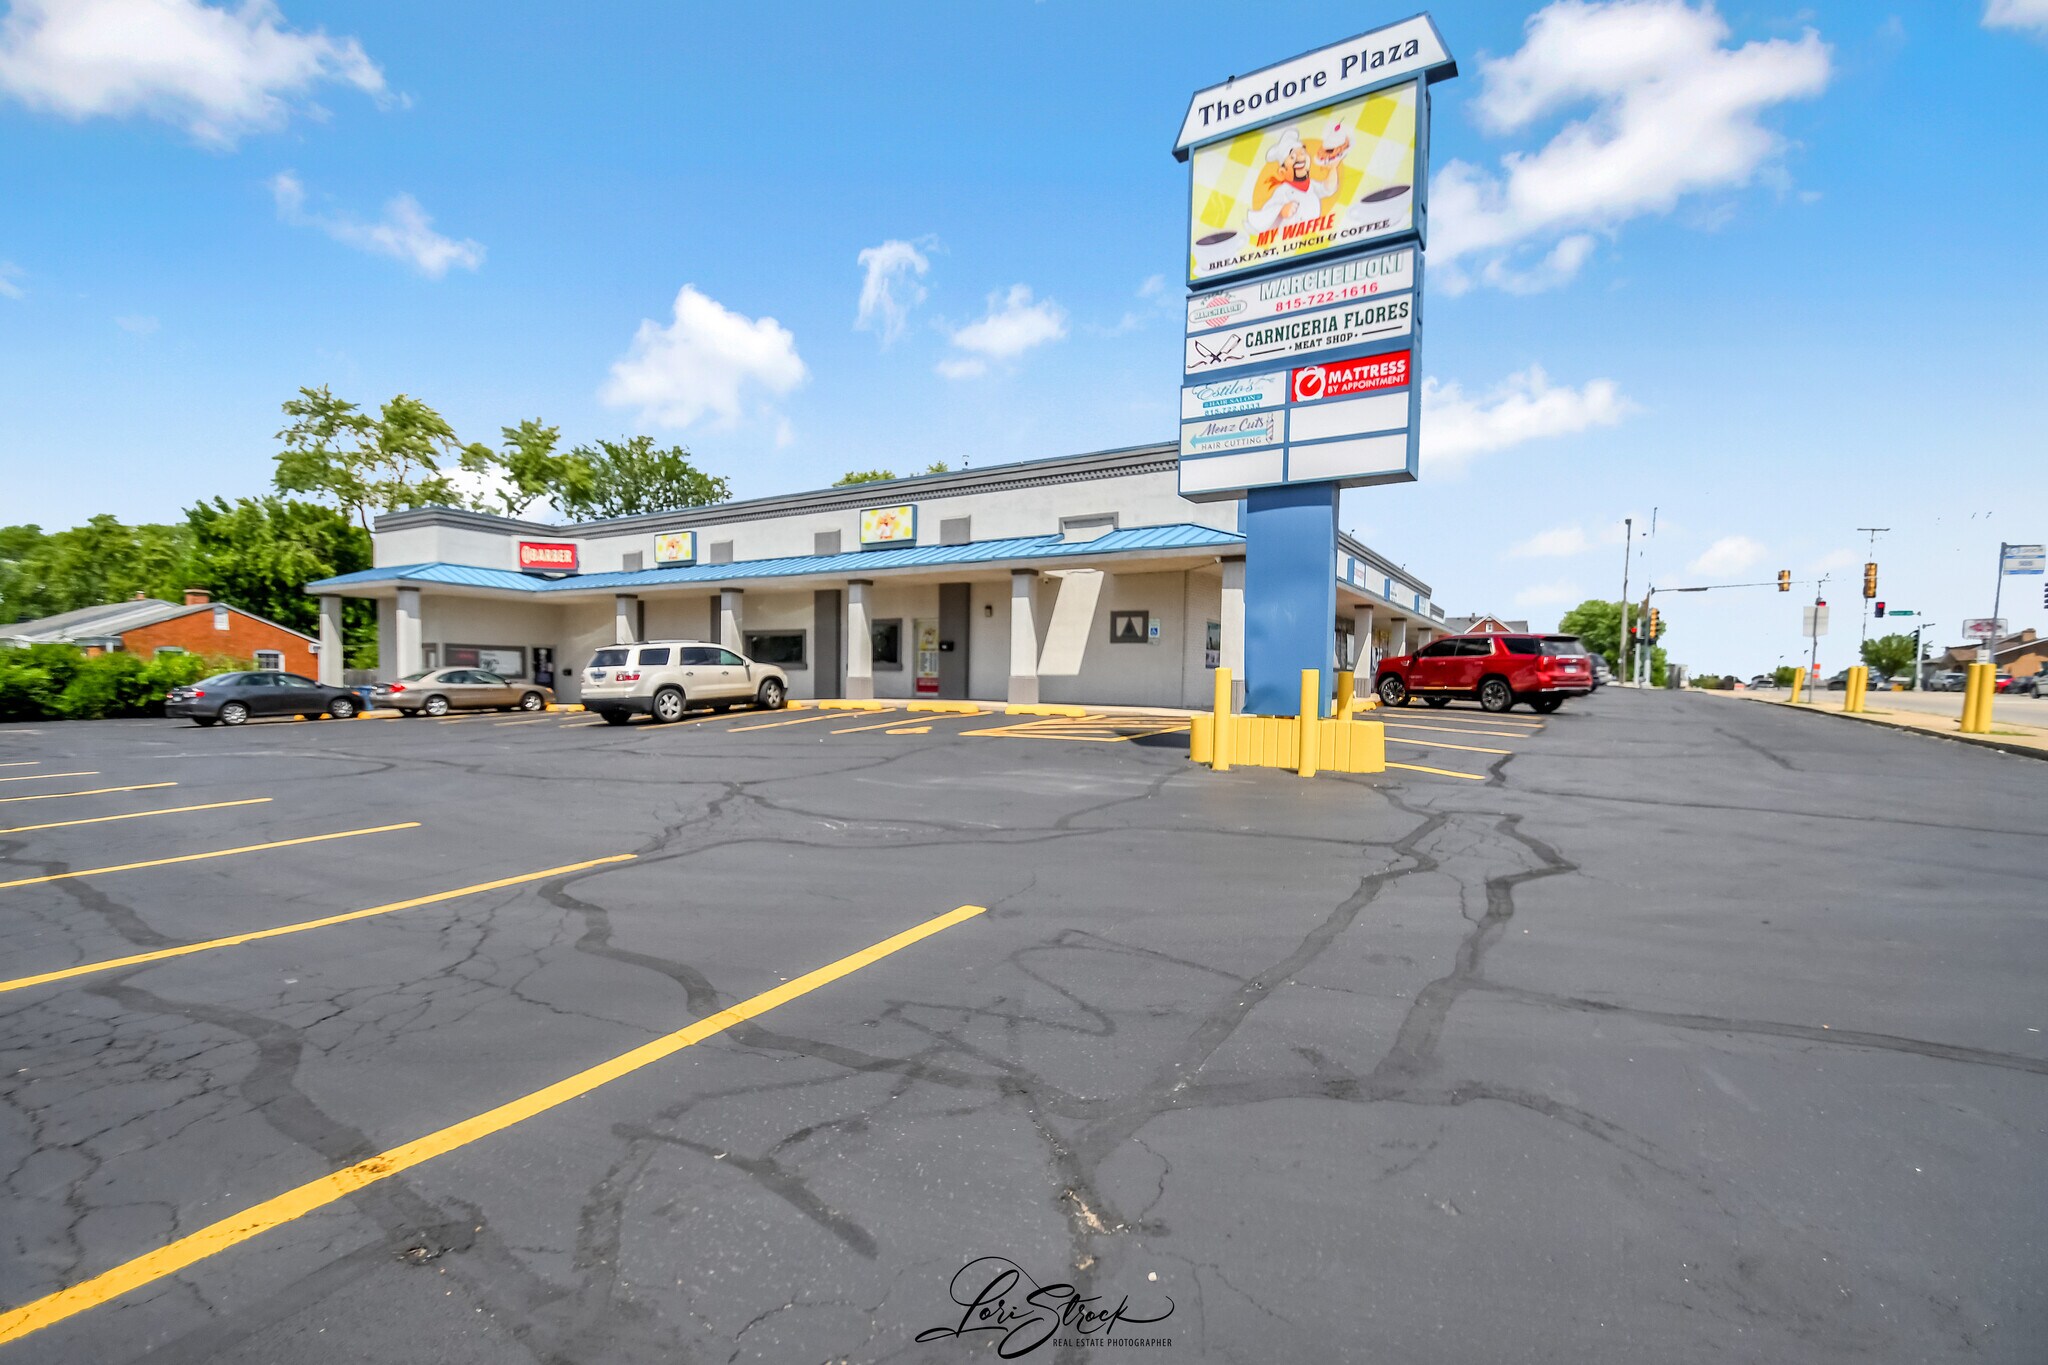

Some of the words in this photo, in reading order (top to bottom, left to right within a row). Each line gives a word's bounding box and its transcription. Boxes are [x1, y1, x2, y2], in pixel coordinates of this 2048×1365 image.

[1198, 70, 1327, 127] Theodore
[1340, 38, 1419, 79] Plaza
[1256, 228, 1278, 247] MY
[1282, 213, 1336, 240] WAFFLE
[1209, 247, 1280, 270] BREAKFAST,
[1283, 236, 1324, 252] LUNCH
[1328, 232, 1337, 241] &
[1340, 219, 1390, 238] COFFEE
[1260, 252, 1404, 301] MARCHELLONI
[1275, 282, 1378, 312] 815-722-1616
[1245, 315, 1338, 348] CARNICERIA
[1344, 301, 1409, 329] FLORES
[1295, 338, 1322, 351] MEAT
[1326, 332, 1353, 345] SHOP
[1327, 384, 1339, 394] BY
[1341, 374, 1405, 391] APPOINTMENT
[1328, 359, 1406, 384] MATTRESS
[1209, 399, 1228, 408] HAIR
[1229, 394, 1256, 405] SALON
[1200, 422, 1236, 436] Menz
[1239, 416, 1265, 432] Cuts
[1201, 442, 1224, 451] HAIR
[1224, 436, 1262, 448] CUTTING
